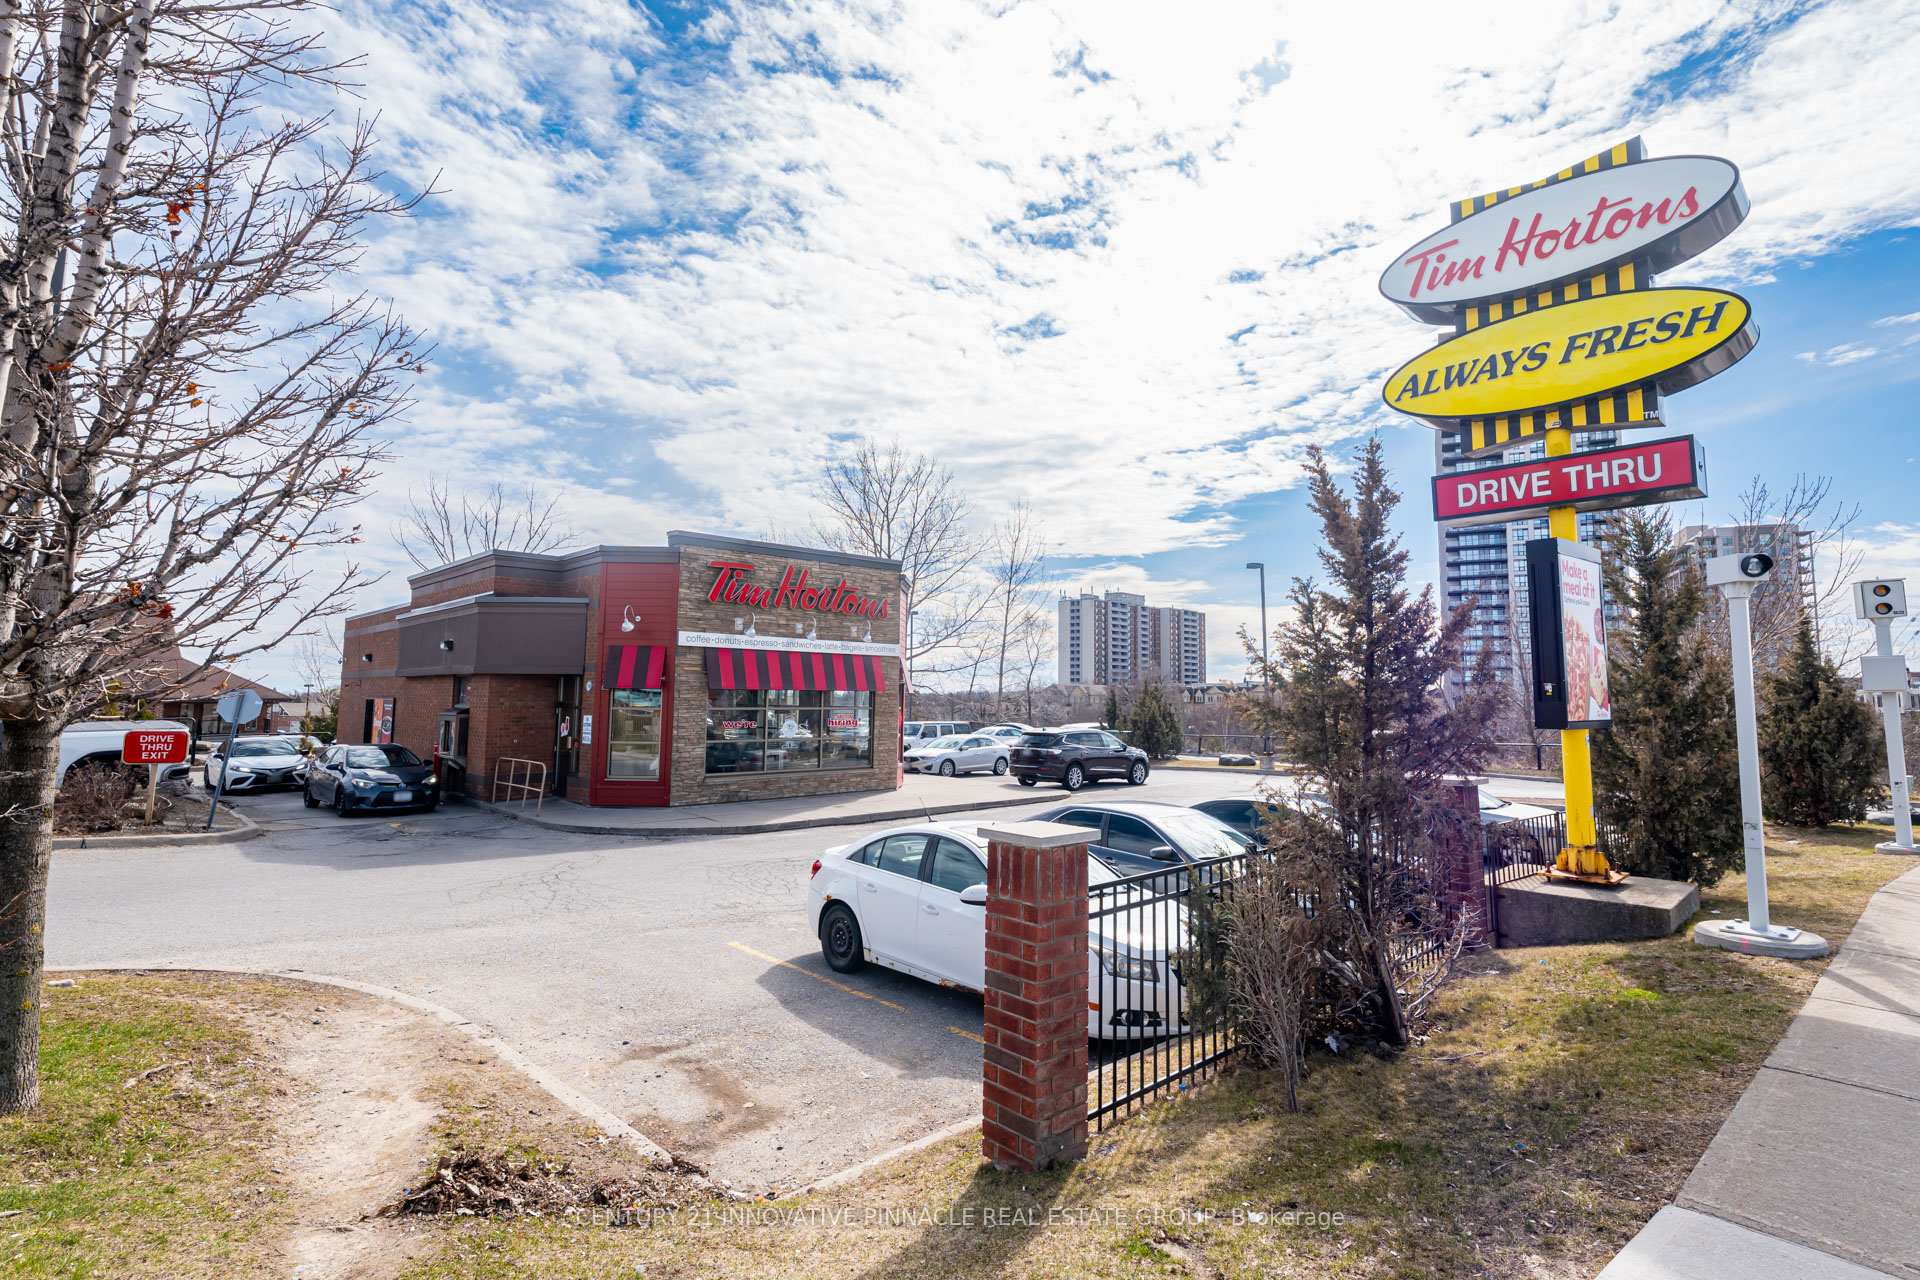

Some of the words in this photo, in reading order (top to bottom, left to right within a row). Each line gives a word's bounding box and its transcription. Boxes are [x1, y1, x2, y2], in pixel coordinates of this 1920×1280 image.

[1405, 239, 1484, 298] Tim
[1494, 186, 1700, 273] Hortons
[1395, 341, 1551, 402] ALWAYS
[1559, 300, 1730, 365] FRESH
[1457, 470, 1552, 508] DRIVE
[1562, 453, 1662, 492] THRU
[1562, 559, 1582, 579] Make
[707, 560, 773, 609] Tim
[774, 563, 890, 620] Hortons
[1563, 581, 1581, 597] meal
[139, 734, 175, 743] DRIVE
[139, 743, 173, 751] THRU
[141, 751, 169, 759] EXIT
